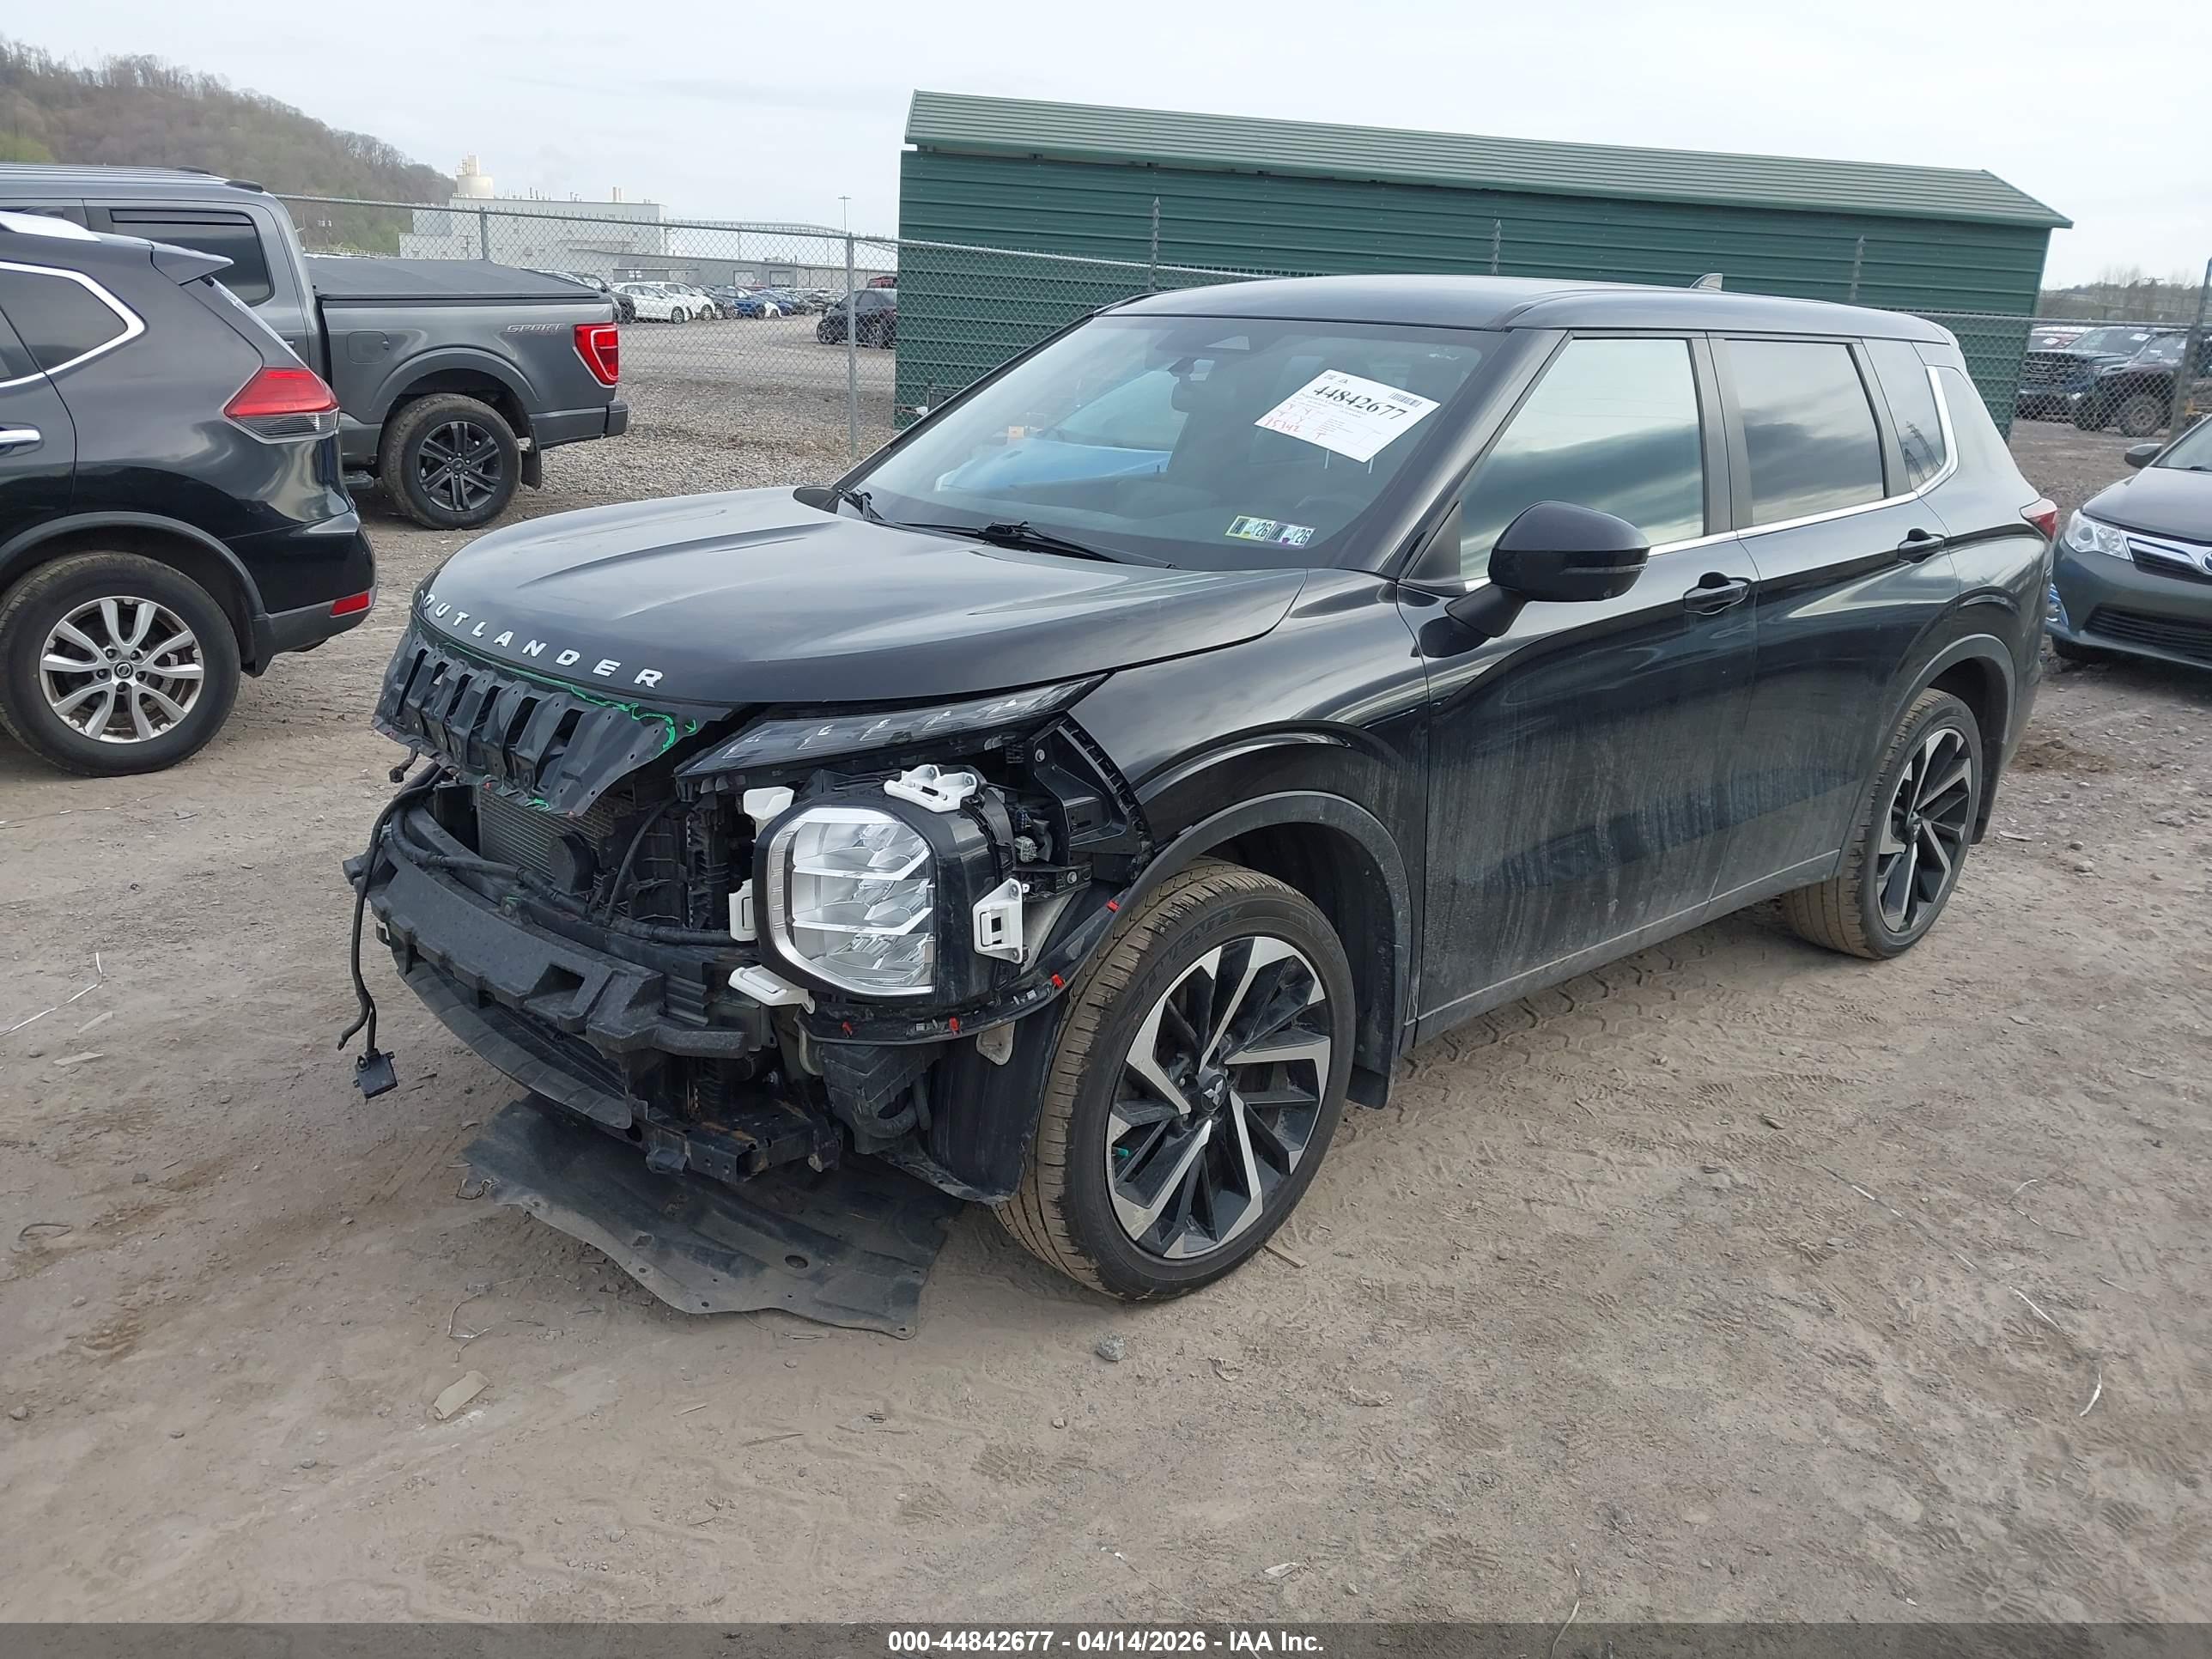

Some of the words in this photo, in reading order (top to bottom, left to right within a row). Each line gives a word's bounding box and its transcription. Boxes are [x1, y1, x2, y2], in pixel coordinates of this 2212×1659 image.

[507, 323, 564, 333] SPORT
[1313, 386, 1408, 420] 44842677
[1255, 522, 1272, 538] 26
[1295, 529, 1311, 544] 26
[422, 592, 665, 690] OUTLANDER
